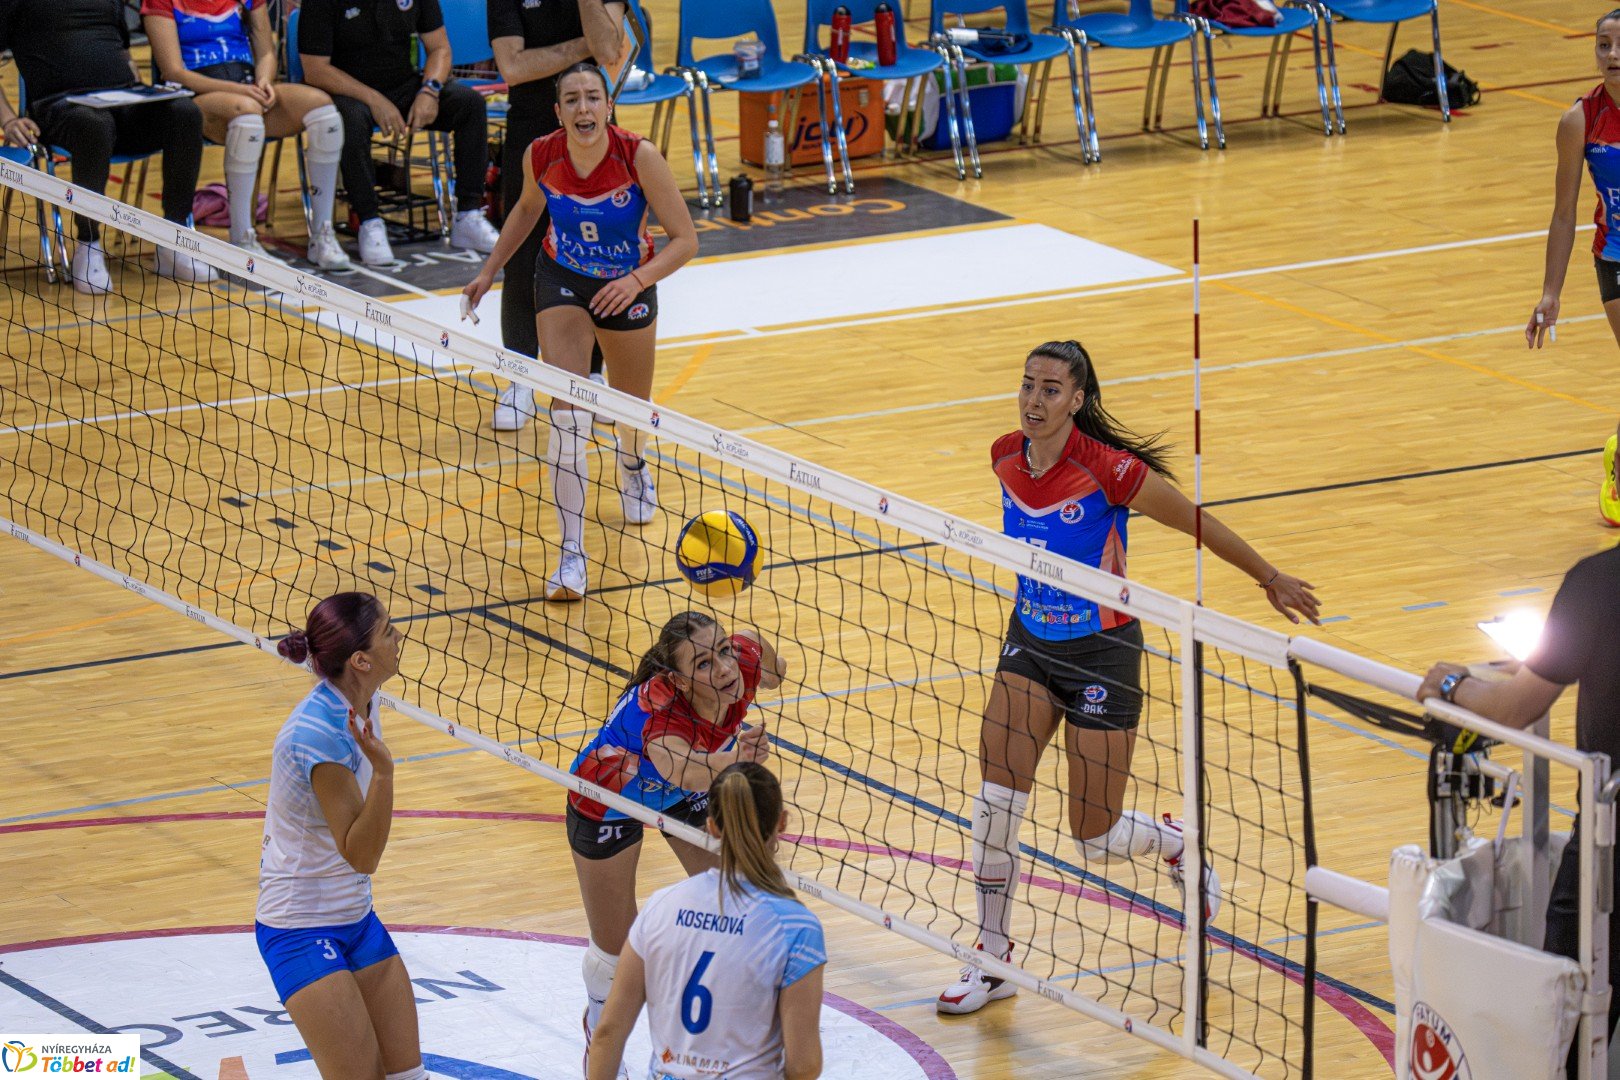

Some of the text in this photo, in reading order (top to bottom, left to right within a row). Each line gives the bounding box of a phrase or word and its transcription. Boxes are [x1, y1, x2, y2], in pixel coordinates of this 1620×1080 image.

[175, 229, 201, 252] FATUM
[580, 221, 599, 242] 8
[365, 302, 392, 326] FATUM
[569, 380, 599, 406] FATUM
[789, 462, 821, 489] FATUM
[10, 524, 30, 544] FATUM
[1030, 552, 1064, 581] FATUM
[185, 605, 207, 624] FATUM
[578, 780, 602, 802] FATUM
[797, 876, 823, 900] FATUM
[676, 908, 747, 935] KOSEKOVÁ
[681, 950, 715, 1035] 6
[1037, 980, 1065, 1004] FATUM
